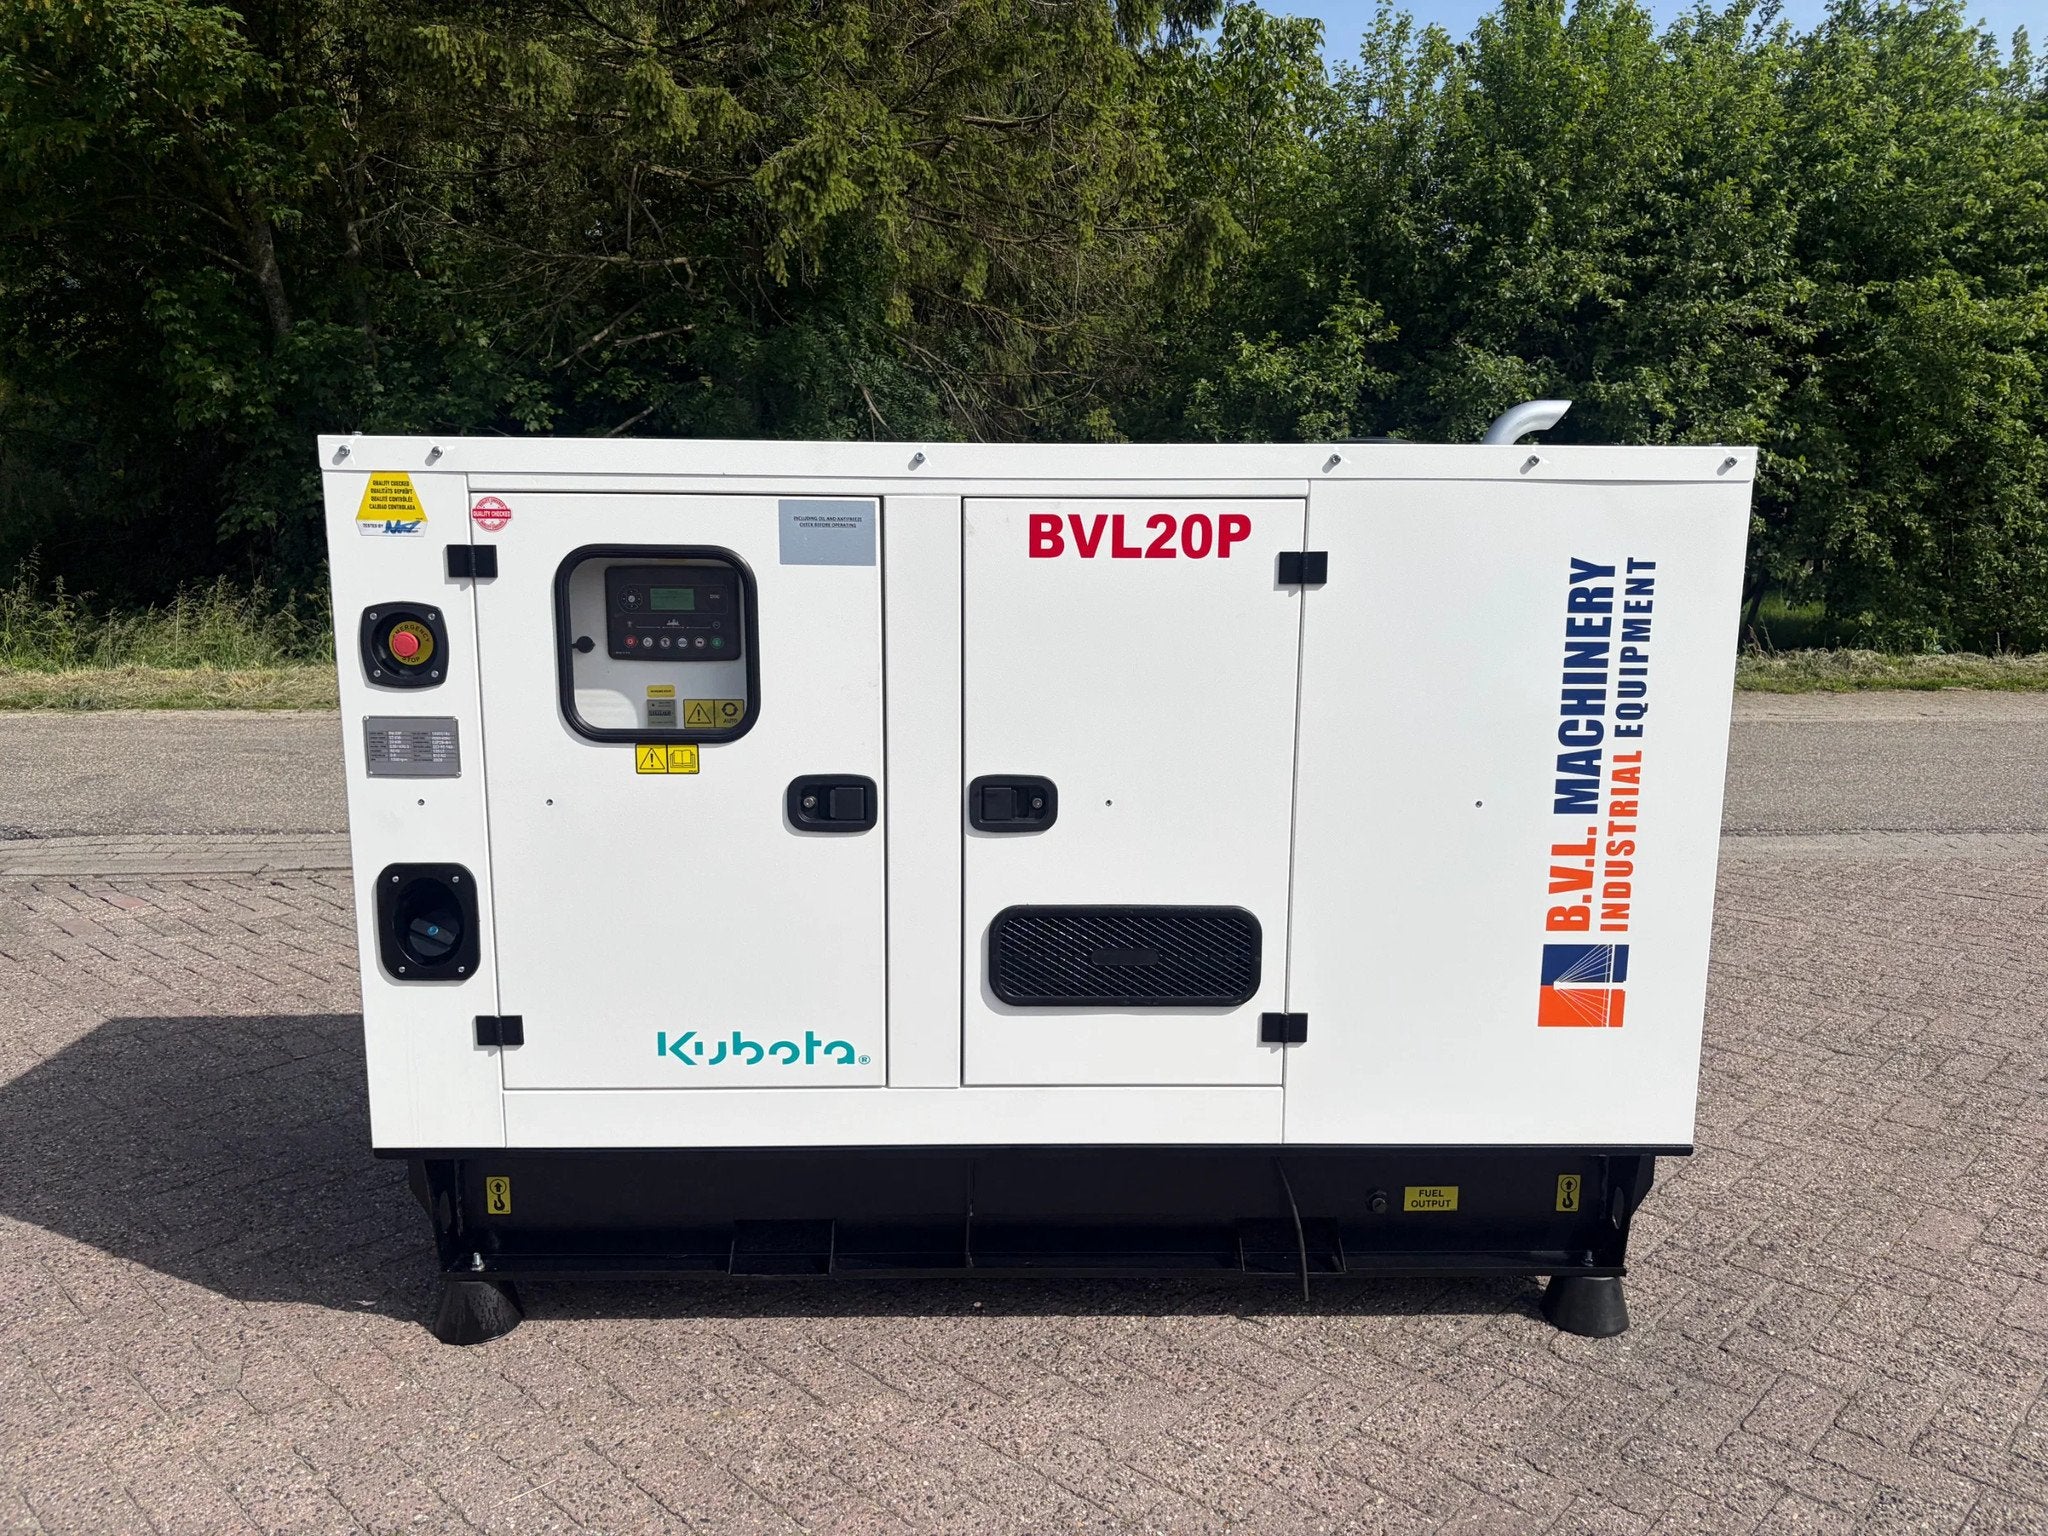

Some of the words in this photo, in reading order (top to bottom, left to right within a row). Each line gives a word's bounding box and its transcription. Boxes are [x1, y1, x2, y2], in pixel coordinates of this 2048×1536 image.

[1029, 513, 1252, 560] BVL20P
[1613, 556, 1657, 738] EQUIPMENT
[1553, 556, 1616, 815] MACHINERY
[1544, 826, 1598, 932] B.V.L.
[1599, 750, 1643, 932] INDUSTRIAL
[657, 1030, 856, 1066] Kubota
[1410, 1199, 1452, 1208] OUTPUT
[1418, 1189, 1445, 1198] FUEL
